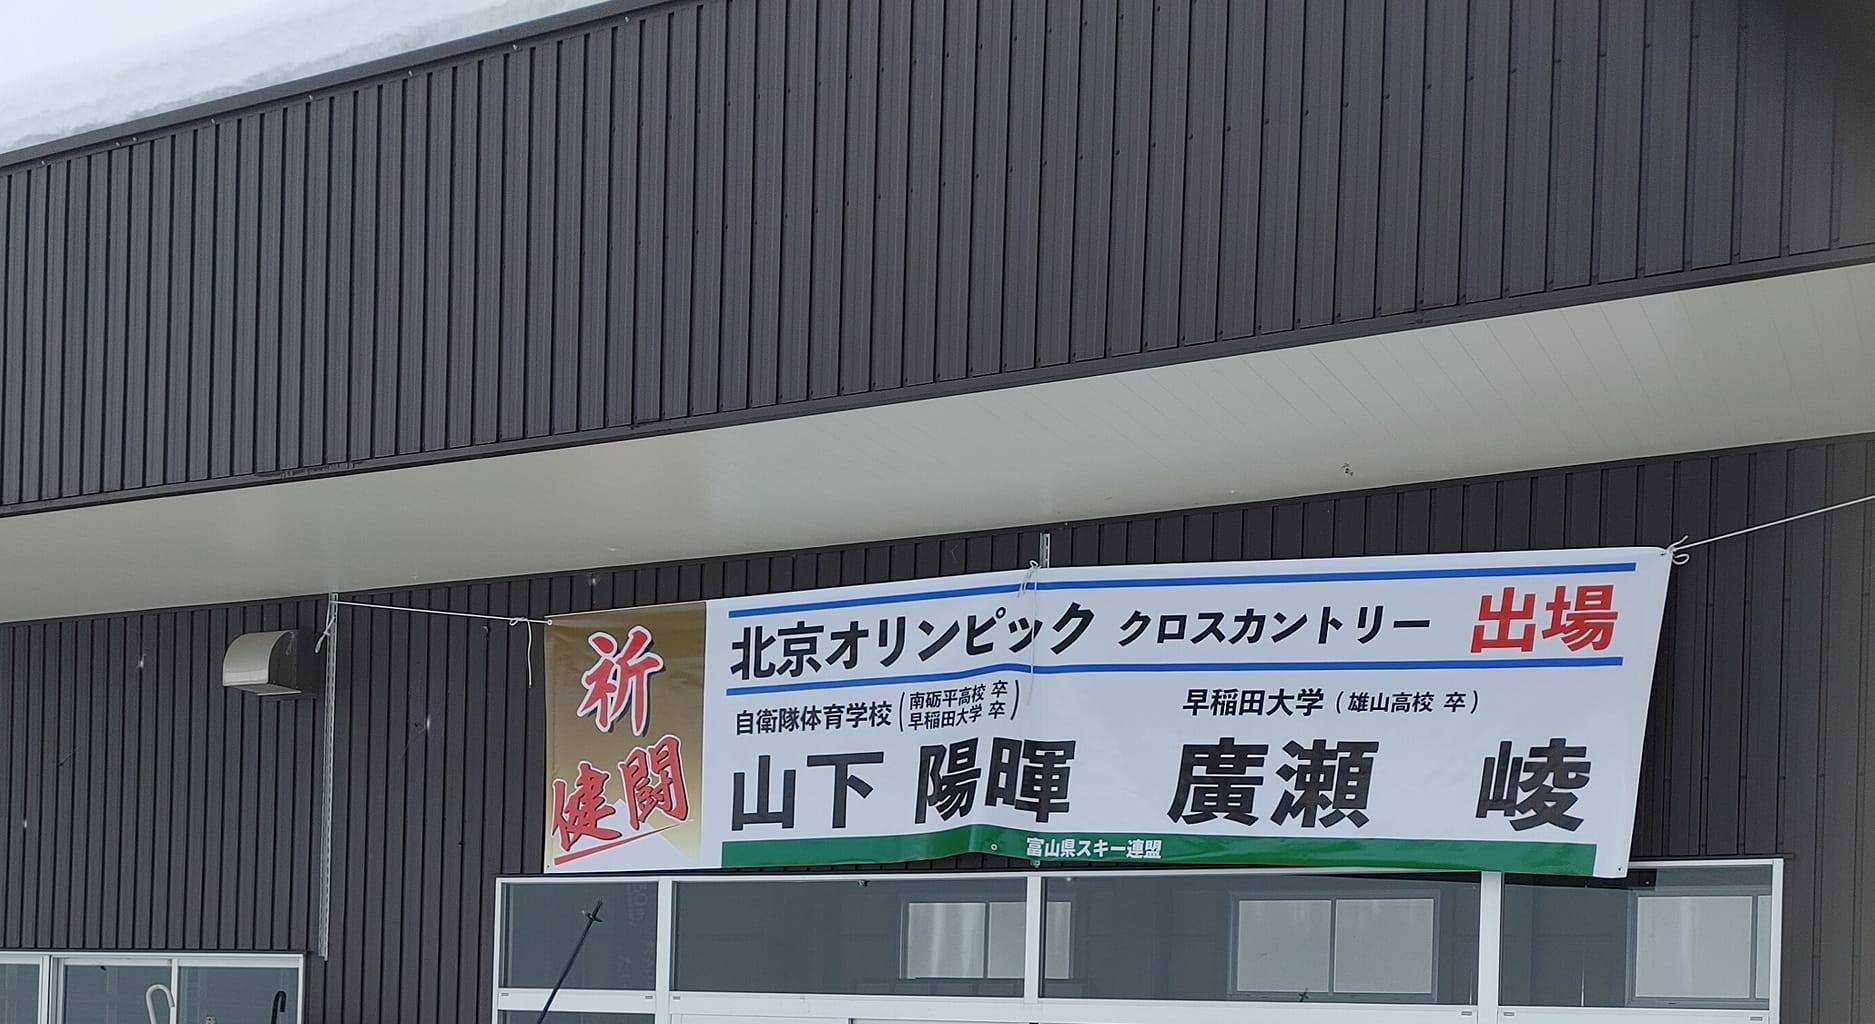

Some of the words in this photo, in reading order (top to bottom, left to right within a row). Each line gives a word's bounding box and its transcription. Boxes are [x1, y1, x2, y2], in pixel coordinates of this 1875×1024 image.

[729, 602, 1095, 681] 北京オリンピック
[1118, 606, 1431, 646] クロスカントリー
[1470, 584, 1619, 653] 出場
[577, 625, 664, 737] 祈
[909, 683, 986, 710] 南砺平高校
[990, 679, 1009, 699] 卒
[736, 700, 893, 736] 自衛隊体育学校
[907, 703, 983, 731] 早稲田大学
[987, 699, 1007, 720] 卒
[1182, 687, 1325, 717] 早稲田大学
[731, 751, 885, 832] 山下
[914, 736, 1077, 826] 陽暉
[1167, 736, 1379, 829] 廣瀬
[1475, 737, 1592, 832] 崚
[1026, 837, 1162, 859] 富山県スキー連盟
